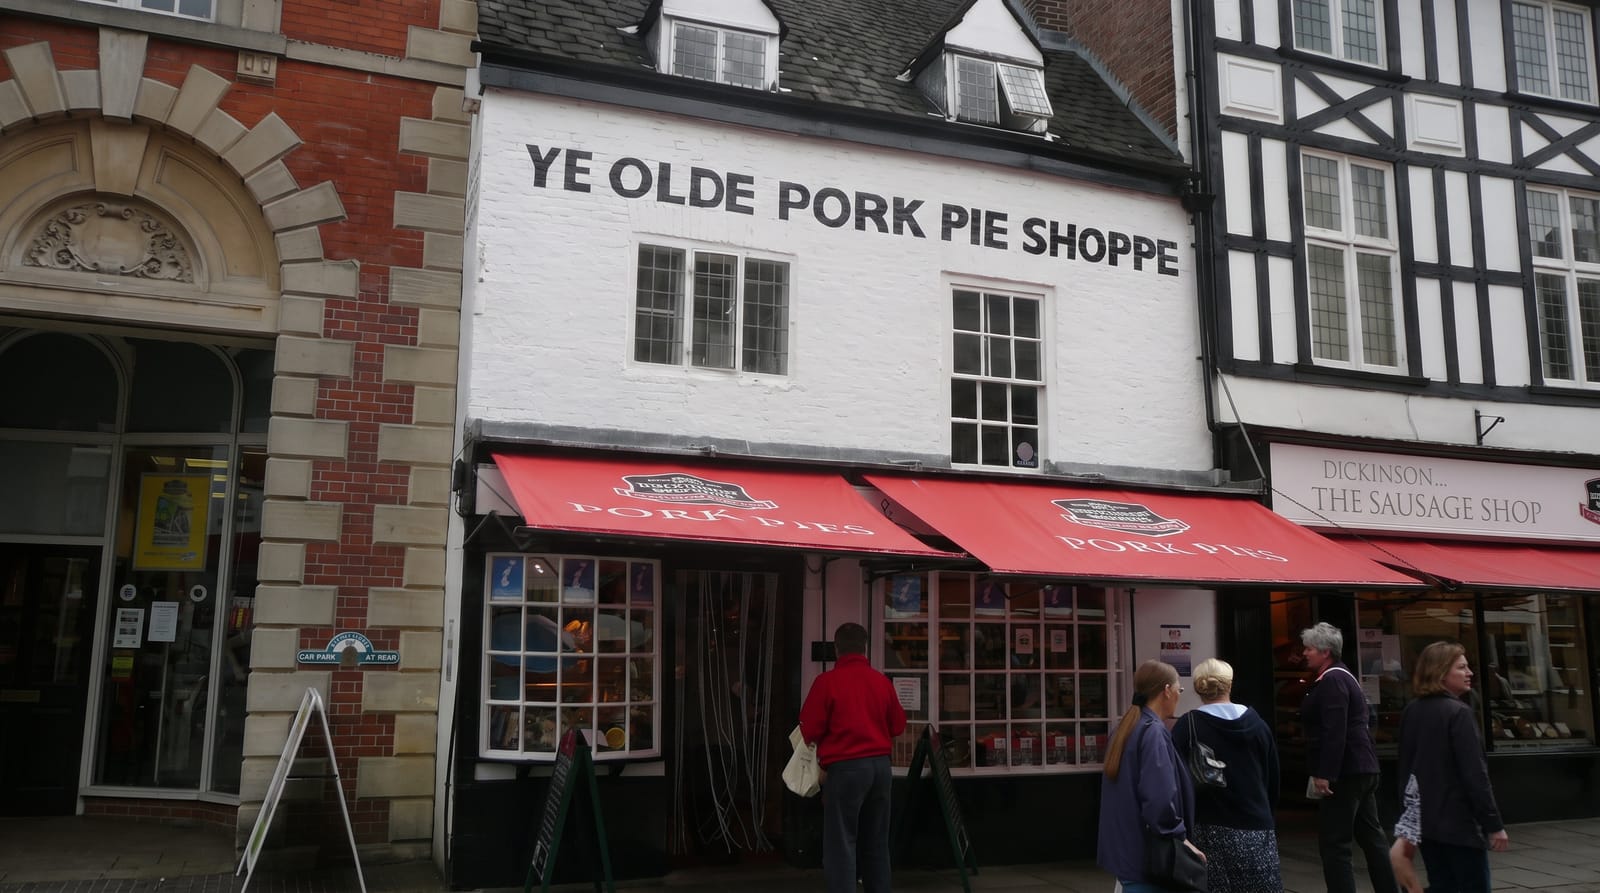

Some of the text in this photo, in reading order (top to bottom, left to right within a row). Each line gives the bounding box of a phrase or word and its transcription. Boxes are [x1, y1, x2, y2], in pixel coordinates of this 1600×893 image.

[526, 144, 592, 192] YE
[609, 158, 754, 215] OLDE
[779, 182, 925, 239] PORK
[942, 204, 1007, 249] PIE
[1023, 217, 1178, 276] SHOPPE
[1323, 460, 1448, 487] DICKINSON...
[567, 501, 875, 536] PORK PIES
[1311, 486, 1541, 524] THE SAUSAGE SHOP
[1056, 535, 1289, 563] PORK PIES
[299, 653, 336, 661] CAR PARK
